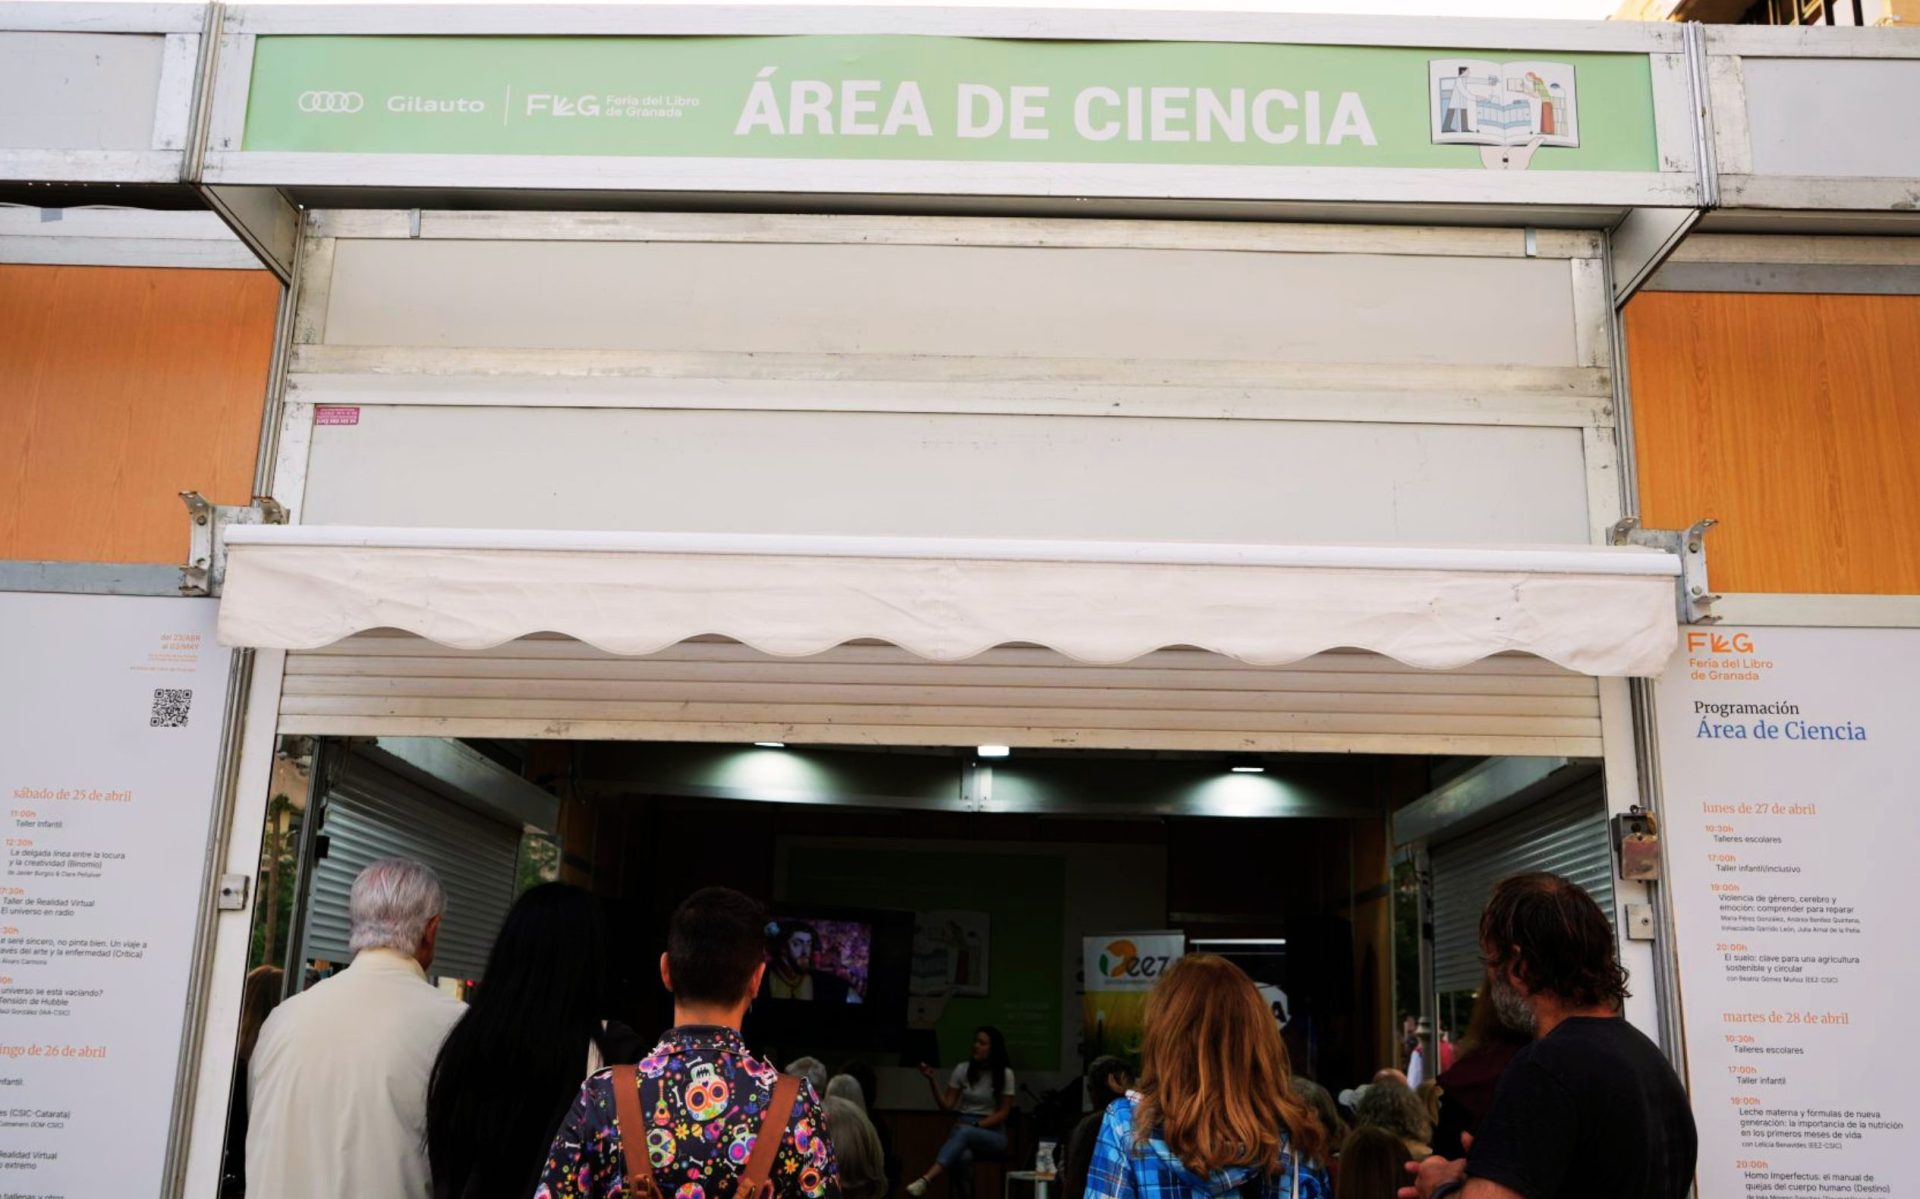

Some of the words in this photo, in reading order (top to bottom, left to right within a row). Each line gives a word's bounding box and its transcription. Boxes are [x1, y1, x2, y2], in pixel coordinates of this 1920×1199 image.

[387, 94, 485, 113] Gilauto
[606, 95, 639, 104] Feria
[643, 96, 662, 105] del
[666, 96, 699, 106] Libro
[606, 107, 622, 116] de
[626, 107, 682, 117] Granada
[734, 68, 933, 137] ÁREA
[959, 84, 1049, 140] DE
[1075, 87, 1378, 147] CIENCIA
[1689, 658, 1719, 668] Feria
[1722, 659, 1740, 669] del
[1744, 660, 1773, 669] Libro
[1691, 671, 1706, 680] de
[1709, 671, 1759, 681] Granada
[1694, 701, 1799, 717] Programación
[1696, 716, 1747, 739] Área
[1754, 720, 1778, 739] de
[1785, 721, 1866, 740] Ciencia
[14, 787, 53, 799] sábado
[56, 788, 69, 800] de
[73, 789, 86, 800] 25
[89, 789, 103, 801] de
[105, 791, 132, 801] abril
[1703, 802, 1735, 814] lunes
[1738, 802, 1750, 814] de
[1755, 803, 1768, 814] 27
[1772, 803, 1786, 815] de
[1788, 804, 1816, 815] abril
[21, 850, 50, 858] delgada
[1708, 854, 1736, 862] 17:00h
[1716, 864, 1736, 872] Taller
[36, 898, 68, 906] Realidad
[1719, 894, 1754, 902] Violencia
[10, 908, 41, 916] universo
[123, 941, 140, 949] viaje
[65, 949, 111, 957] enfermedad
[1725, 953, 1731, 961] El
[1818, 956, 1860, 965] agricultura
[1726, 964, 1765, 972] sostenible
[41, 998, 69, 1006] Hubble
[1723, 1012, 1765, 1023] martes
[1768, 1011, 1783, 1023] de
[1787, 1012, 1801, 1023] 28
[1804, 1012, 1818, 1024] de
[1821, 1013, 1849, 1025] abril
[28, 1044, 41, 1056] de
[46, 1045, 59, 1057] 26
[62, 1045, 75, 1057] de
[78, 1046, 106, 1058] abril
[1766, 1046, 1804, 1054] escolares
[1728, 1066, 1757, 1074] 17:00h
[1737, 1076, 1758, 1084] Taller
[1760, 1076, 1786, 1085] infantil
[1739, 1108, 1764, 1116] Leche
[1807, 1109, 1842, 1118] fórmulas
[1844, 1110, 1855, 1118] de
[1798, 1120, 1845, 1129] importancia
[1859, 1121, 1866, 1129] la
[1868, 1121, 1903, 1130] nutrición
[1753, 1129, 1765, 1137] los
[1767, 1131, 1802, 1139] primeros
[1832, 1131, 1843, 1139] de
[1845, 1131, 1862, 1139] vida
[32, 1152, 57, 1160] Virtual
[5, 1162, 37, 1170] extremo
[1745, 1172, 1769, 1180] Homo
[1832, 1174, 1861, 1182] manual
[1863, 1174, 1874, 1182] de
[1746, 1183, 1772, 1191] quejas
[1774, 1183, 1786, 1191] del
[1819, 1184, 1852, 1192] humano
[1854, 1184, 1890, 1193] (Destino)
